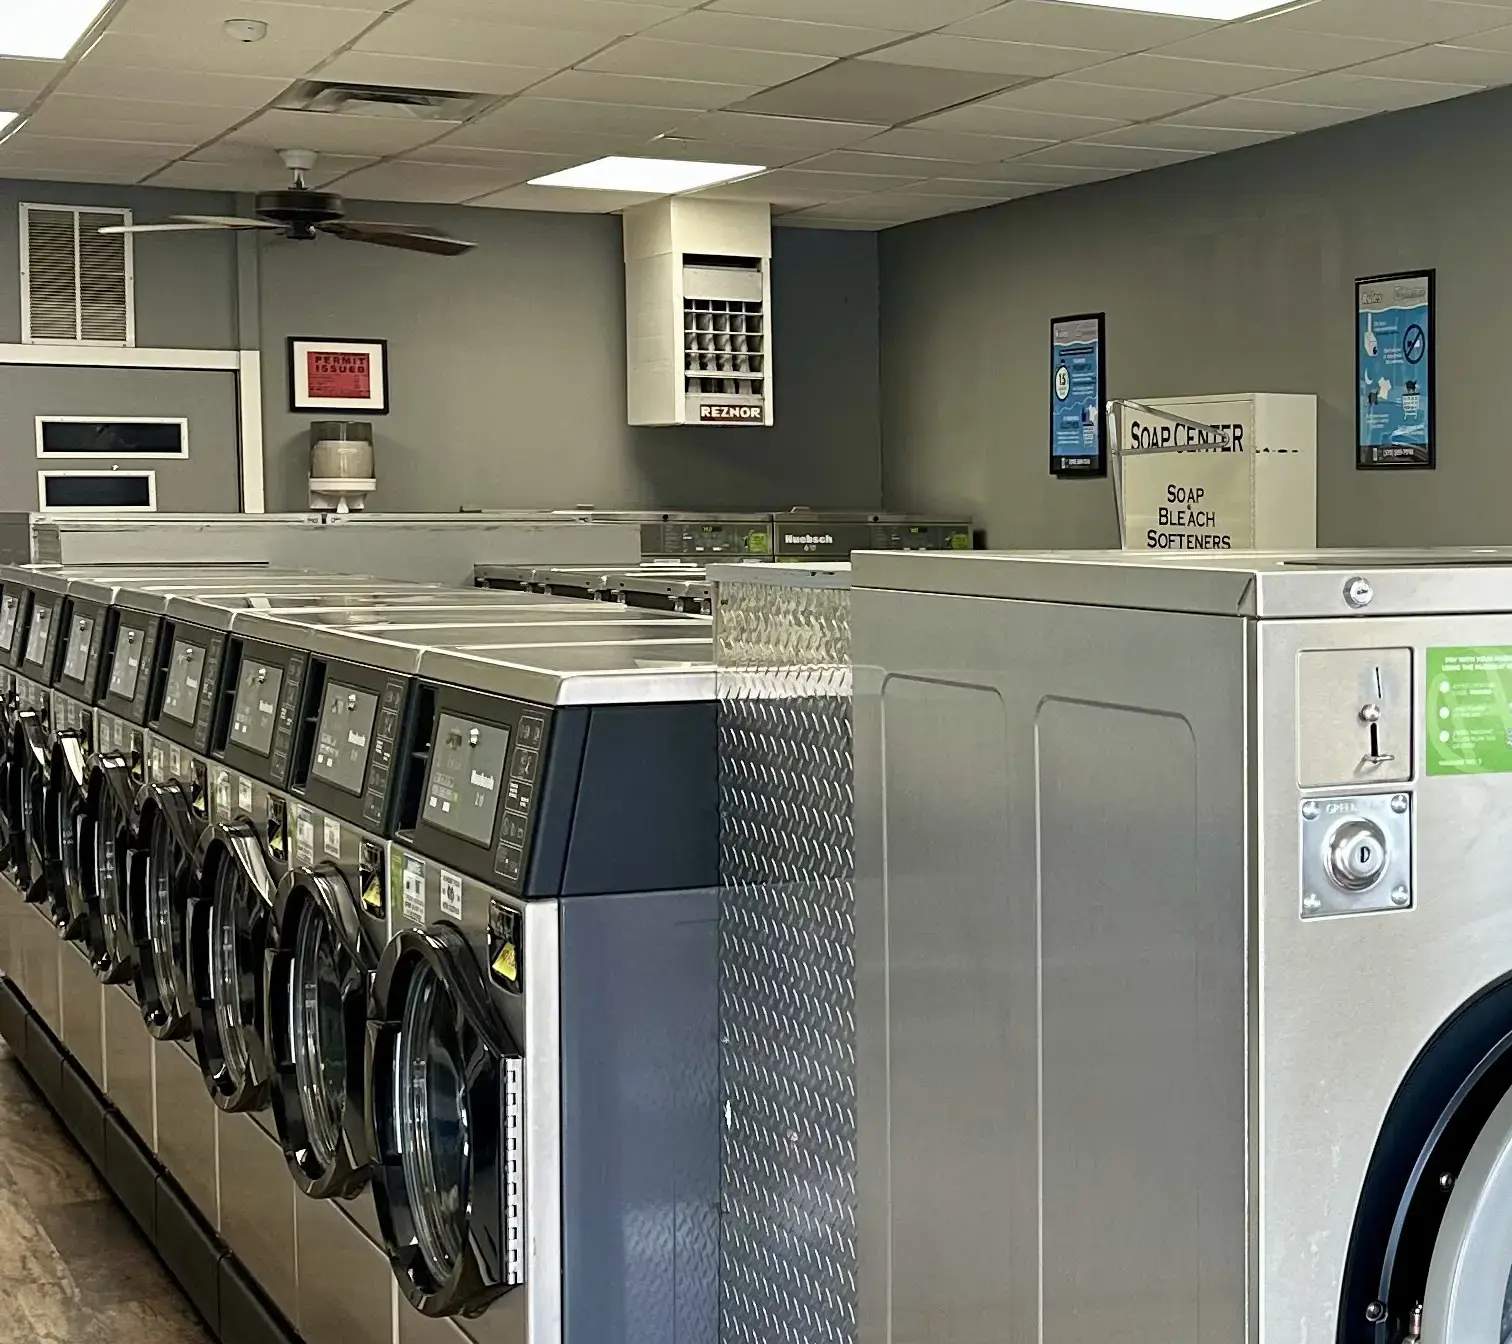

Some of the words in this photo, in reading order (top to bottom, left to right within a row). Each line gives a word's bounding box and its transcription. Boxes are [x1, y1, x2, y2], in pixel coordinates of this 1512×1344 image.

[315, 356, 366, 365] PERMIT
[316, 365, 365, 373] ISSUED
[701, 406, 760, 418] REZNOR
[1131, 421, 1171, 452] SOAP
[1167, 484, 1204, 504] SOAP
[1158, 507, 1215, 527] BLEACH
[785, 534, 833, 544] Huebsch
[1147, 529, 1231, 549] SOFTENERS
